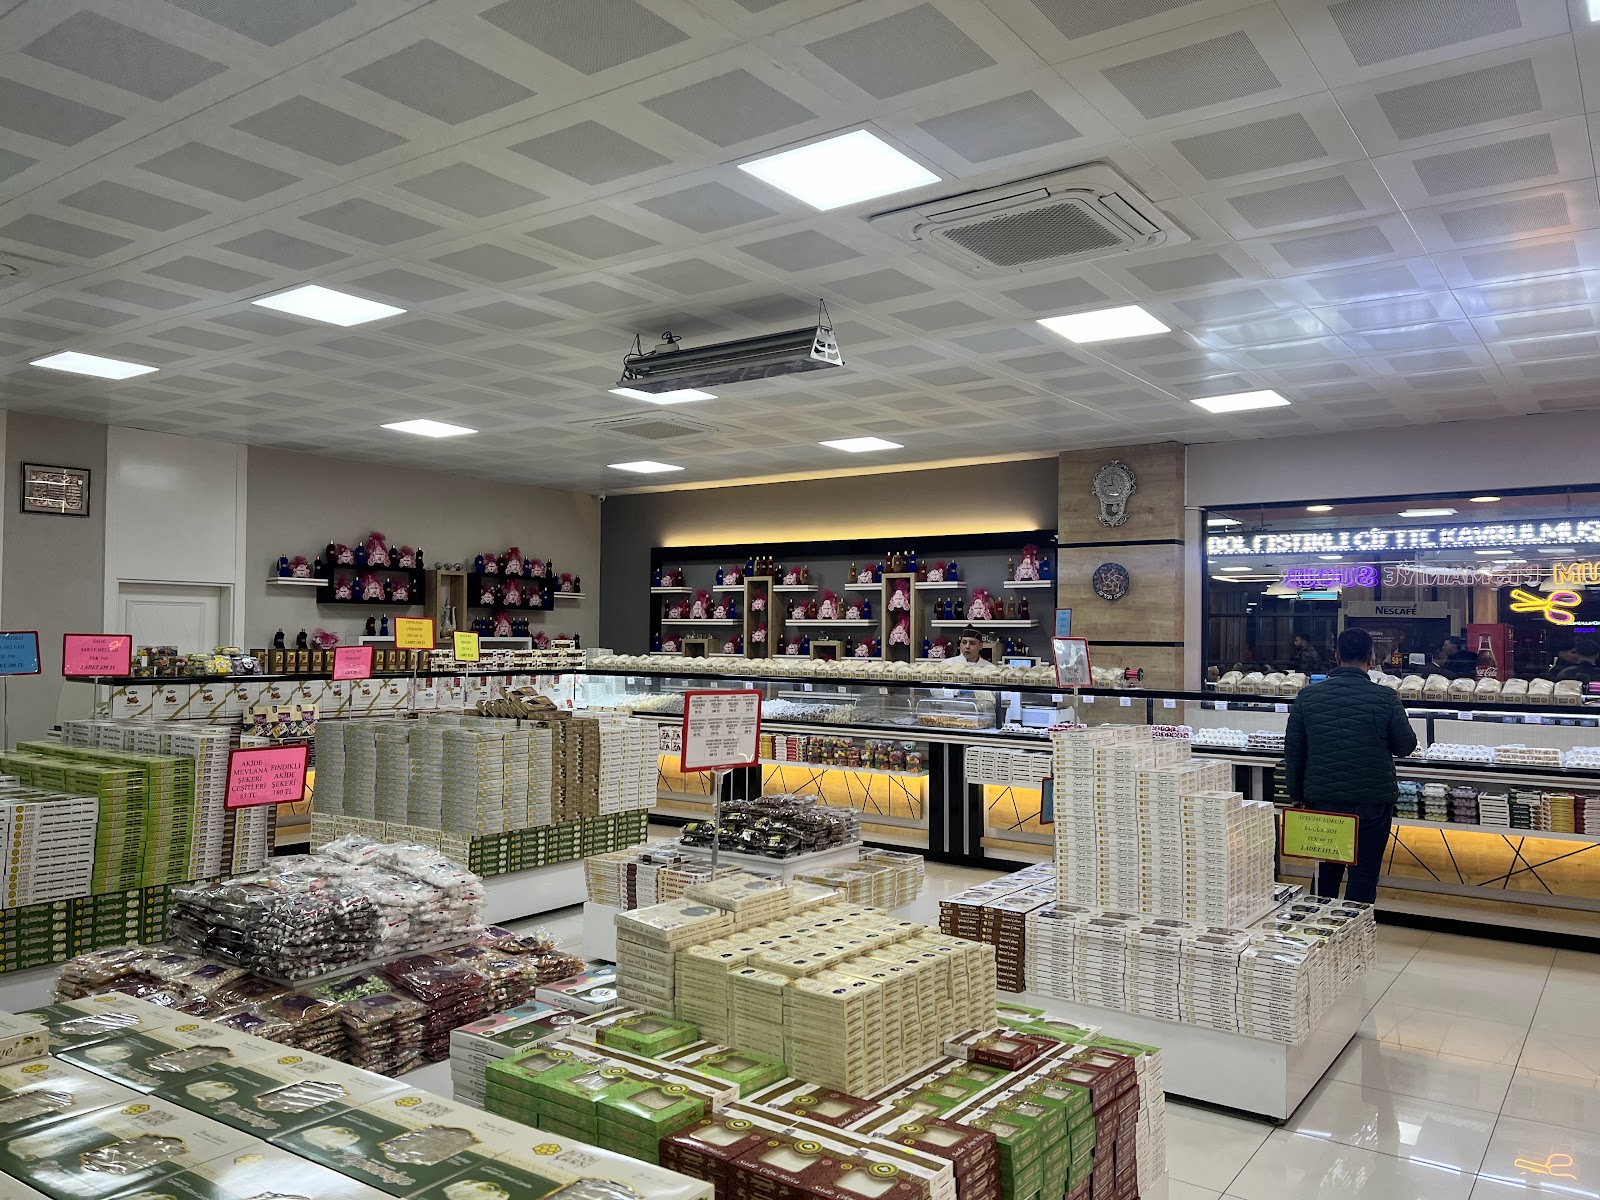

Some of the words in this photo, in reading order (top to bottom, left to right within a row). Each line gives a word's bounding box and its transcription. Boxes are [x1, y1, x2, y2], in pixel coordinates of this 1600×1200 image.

[1375, 603, 1417, 616] NESCAFÉ
[270, 763, 301, 771] FINDIKLI
[233, 768, 268, 776] MEVLANA
[238, 775, 262, 784] ŞEKERİ
[231, 783, 267, 792] ÇEŞİTLERİ
[271, 780, 296, 788] ŞEKERİ
[1323, 817, 1345, 825] LOKUM
